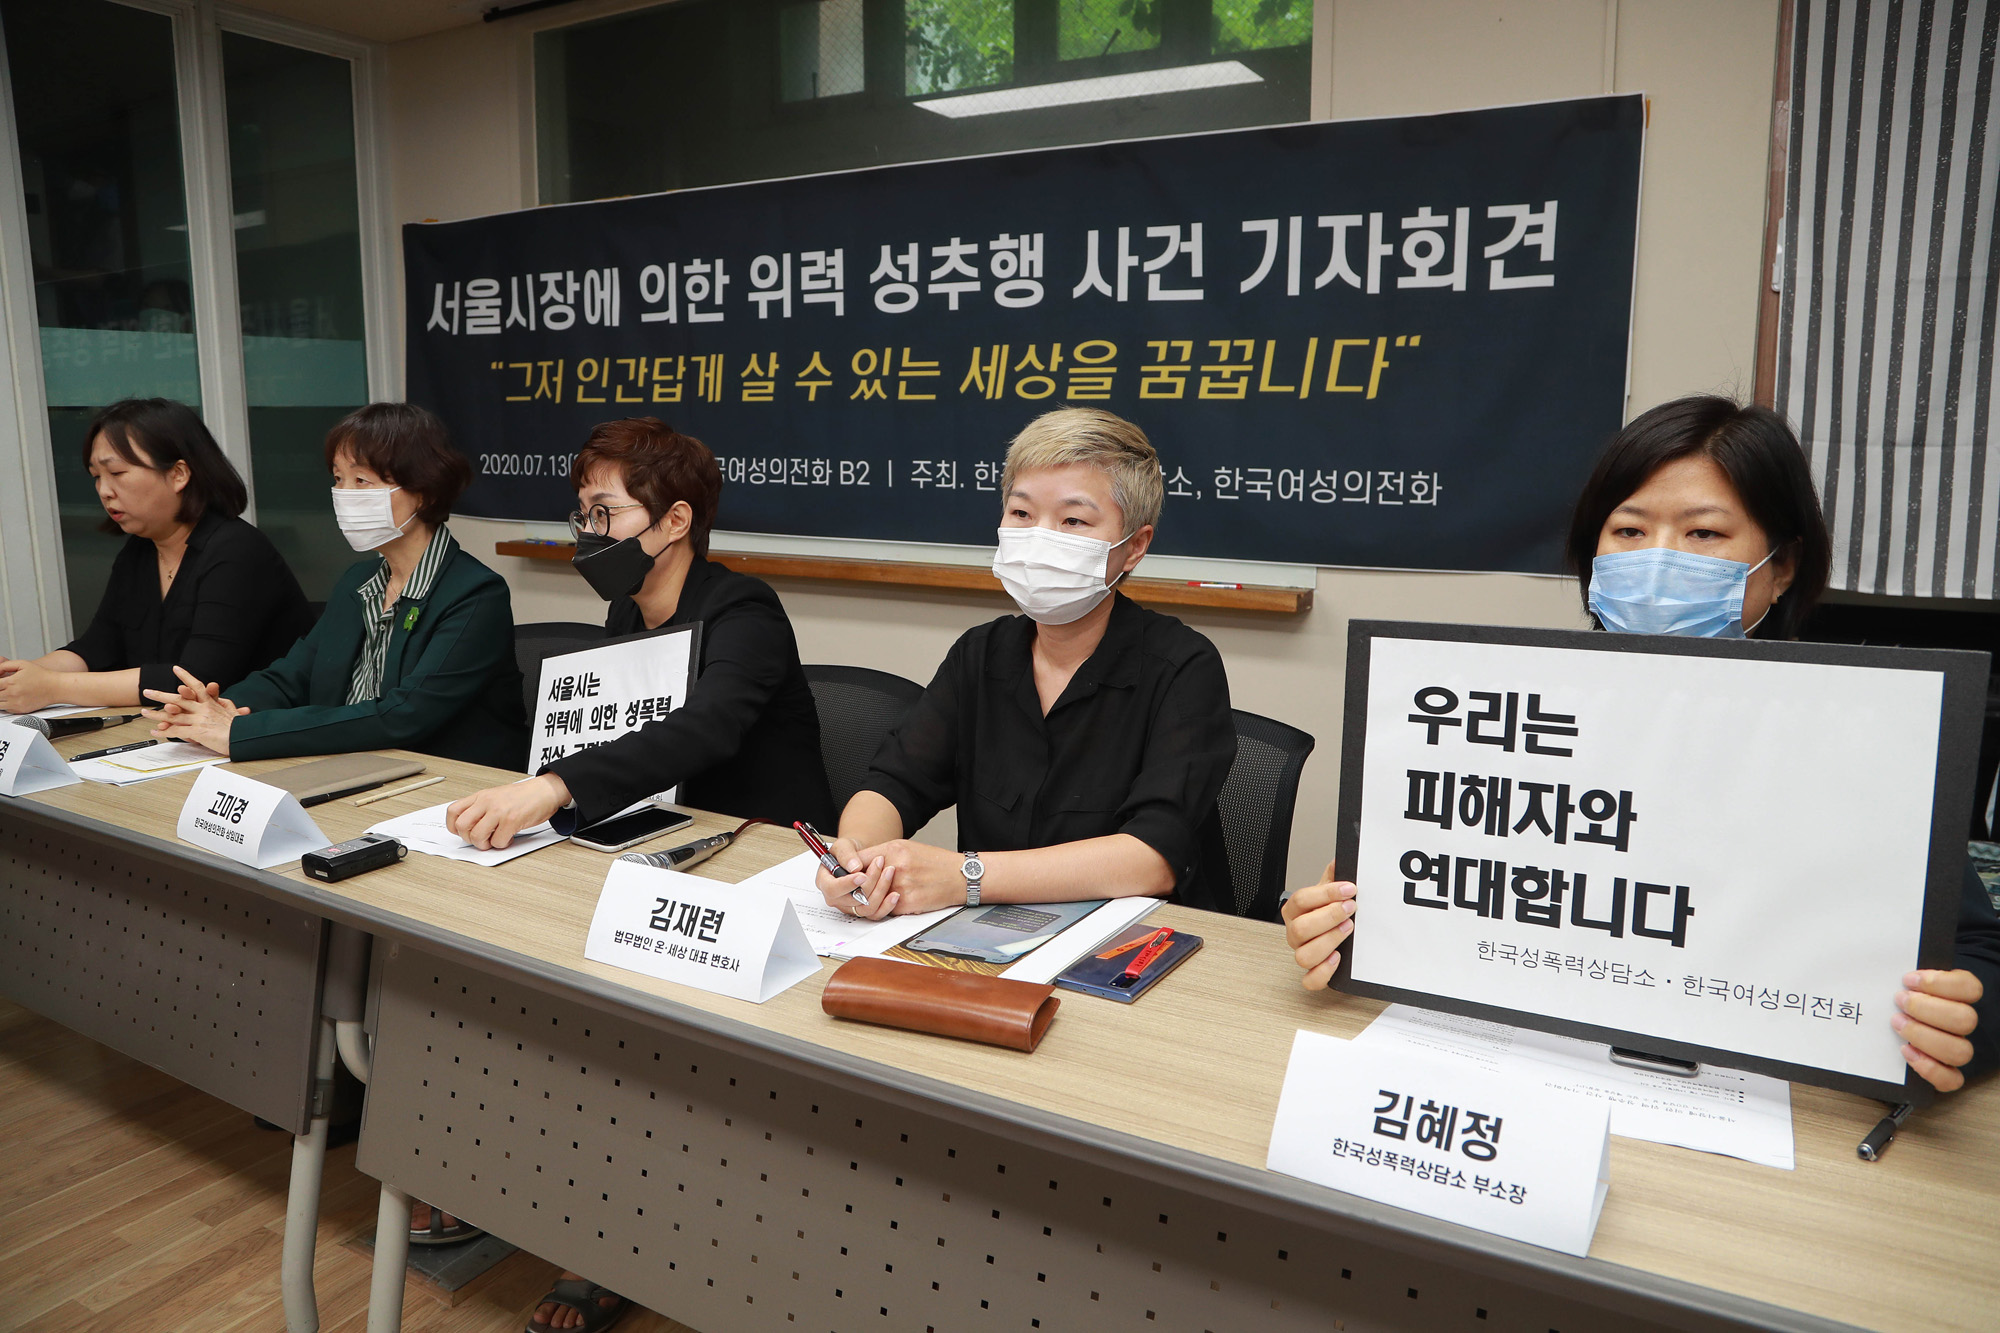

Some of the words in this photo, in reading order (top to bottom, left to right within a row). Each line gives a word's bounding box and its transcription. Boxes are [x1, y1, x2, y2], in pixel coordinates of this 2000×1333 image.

[427, 267, 621, 335] 서울시장에
[639, 258, 730, 324] 의한
[747, 248, 845, 319] 위력
[869, 232, 1045, 314] 성추행
[1072, 222, 1204, 302] 사건
[1240, 200, 1558, 297] 기자회견
[576, 353, 724, 403] 인간답게
[740, 352, 780, 402] 살
[795, 351, 833, 402] 수
[850, 347, 941, 400] 있는
[959, 339, 1118, 400] 세상을
[839, 460, 870, 486] B2
[910, 459, 964, 490] 주최.
[1214, 466, 1443, 506] 한국여성의전화
[544, 707, 584, 738] 위력에
[588, 702, 618, 732] 의한
[625, 695, 672, 727] 성폭력
[547, 671, 601, 703] 서울시는
[1407, 686, 1579, 758] 우리는
[207, 790, 250, 825] 고미경
[1403, 769, 1637, 852] 피해자와
[649, 897, 726, 943] 김재련
[1399, 849, 1695, 948] 연대합니다
[614, 929, 654, 951] 법무법인
[688, 948, 709, 965] 대표
[710, 953, 740, 973] 변호사
[1477, 939, 1657, 989] 한국성폭력상담소
[1682, 975, 1863, 1025] 한국여성의전화
[1373, 1089, 1503, 1162] 김혜정
[1332, 1137, 1468, 1190] 한국성폭력상담소
[1472, 1174, 1527, 1205] 부소장
